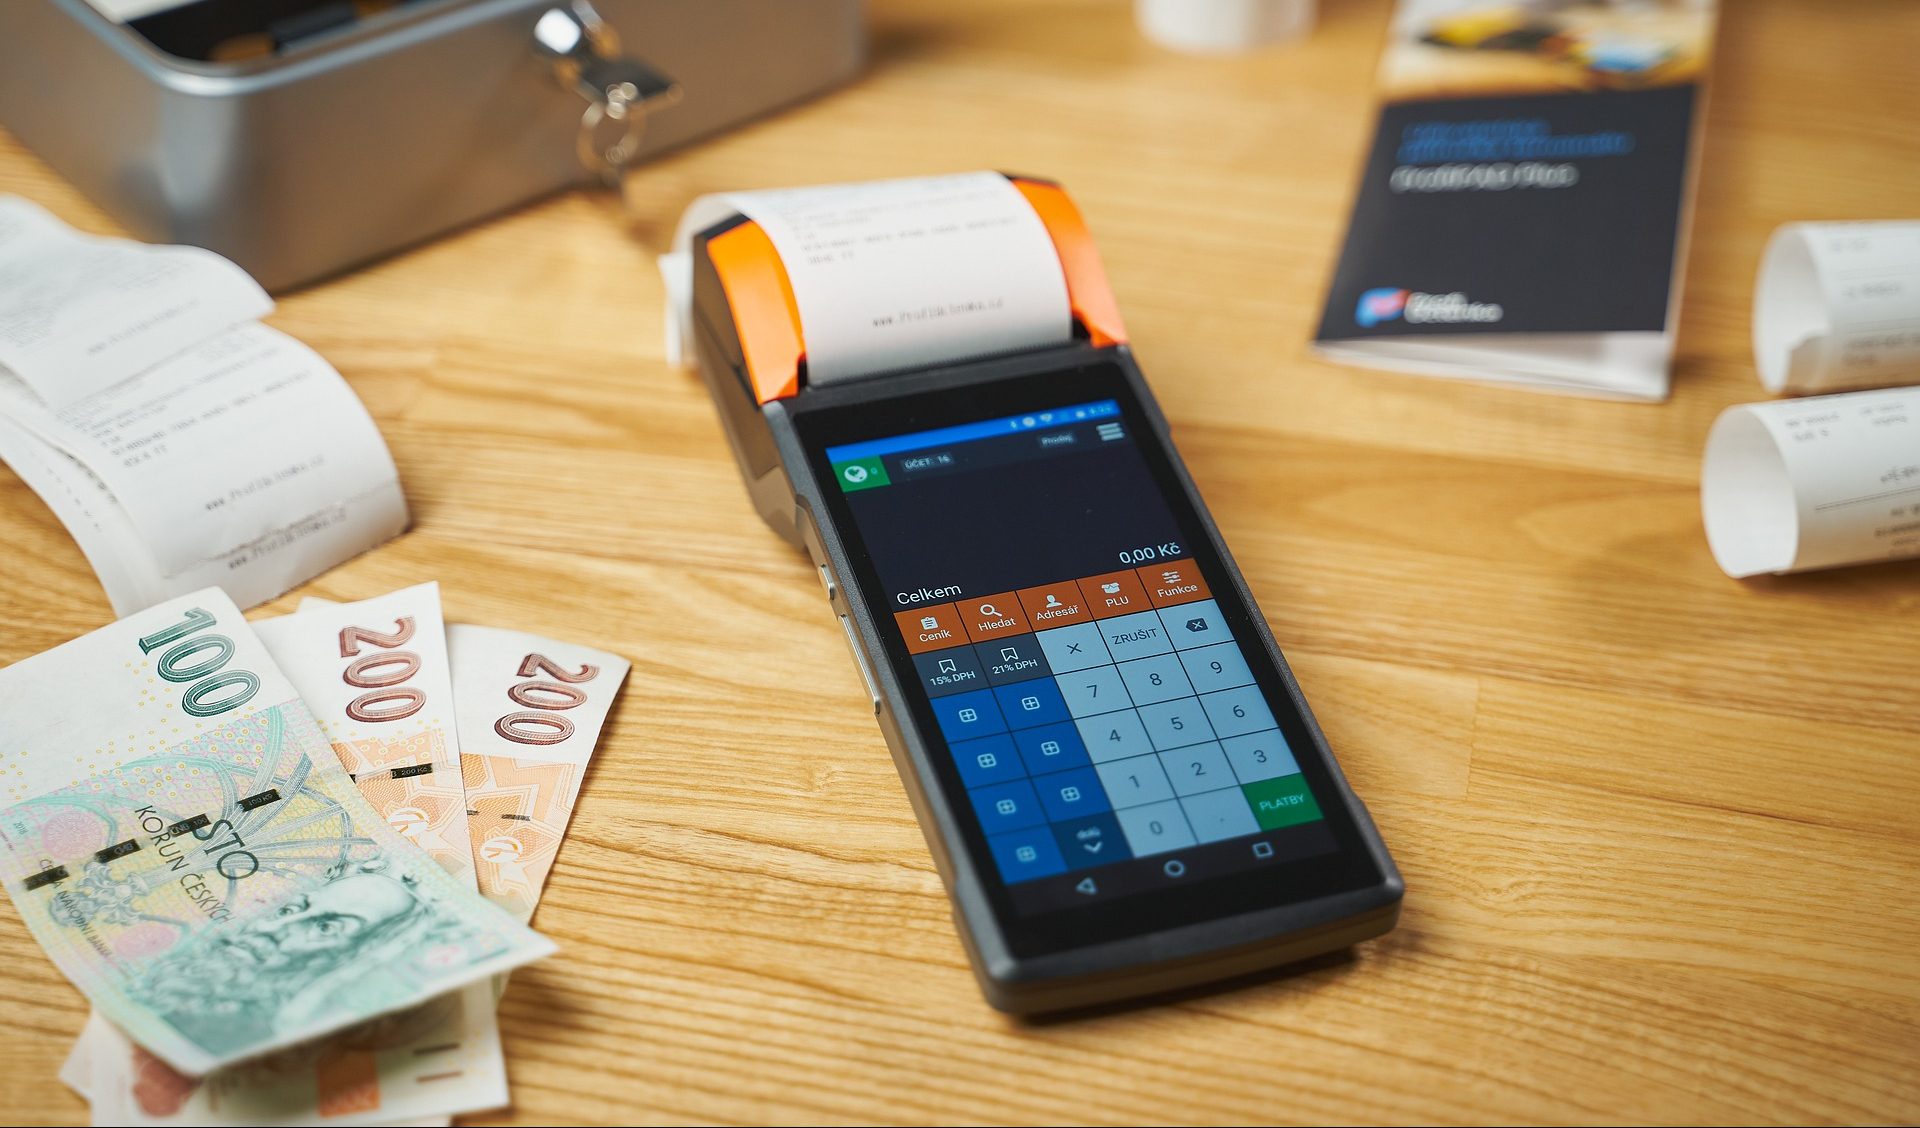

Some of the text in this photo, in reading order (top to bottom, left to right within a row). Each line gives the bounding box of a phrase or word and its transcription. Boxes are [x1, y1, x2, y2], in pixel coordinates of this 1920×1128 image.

[1119, 542, 1181, 564] 0,00 Kč
[896, 584, 962, 605] Celkem
[1157, 584, 1198, 598] Funkce
[1105, 596, 1129, 608] PLU
[1036, 605, 1079, 621] Adresář
[978, 617, 1017, 632] Hledat
[919, 629, 952, 642] Ceník
[1112, 628, 1157, 645] ZRUŠIT
[138, 607, 261, 718] 100
[338, 616, 427, 723] 200
[992, 659, 1038, 675] 21% DPH
[1210, 661, 1223, 674] 9
[930, 670, 976, 686] 15% DPH
[1149, 673, 1162, 686] 8
[1086, 685, 1098, 698] 7
[494, 654, 600, 746] 200
[1232, 705, 1245, 718] 6
[1171, 717, 1184, 730] 5
[1109, 729, 1121, 742] 4
[1253, 750, 1267, 763] 3
[1191, 762, 1206, 776] 2
[1129, 775, 1140, 788] 1
[1258, 794, 1305, 811] PLATBY
[1150, 820, 1163, 835] 0
[192, 819, 259, 880] STO
[135, 805, 237, 924] KORUN ČESKÝCH
